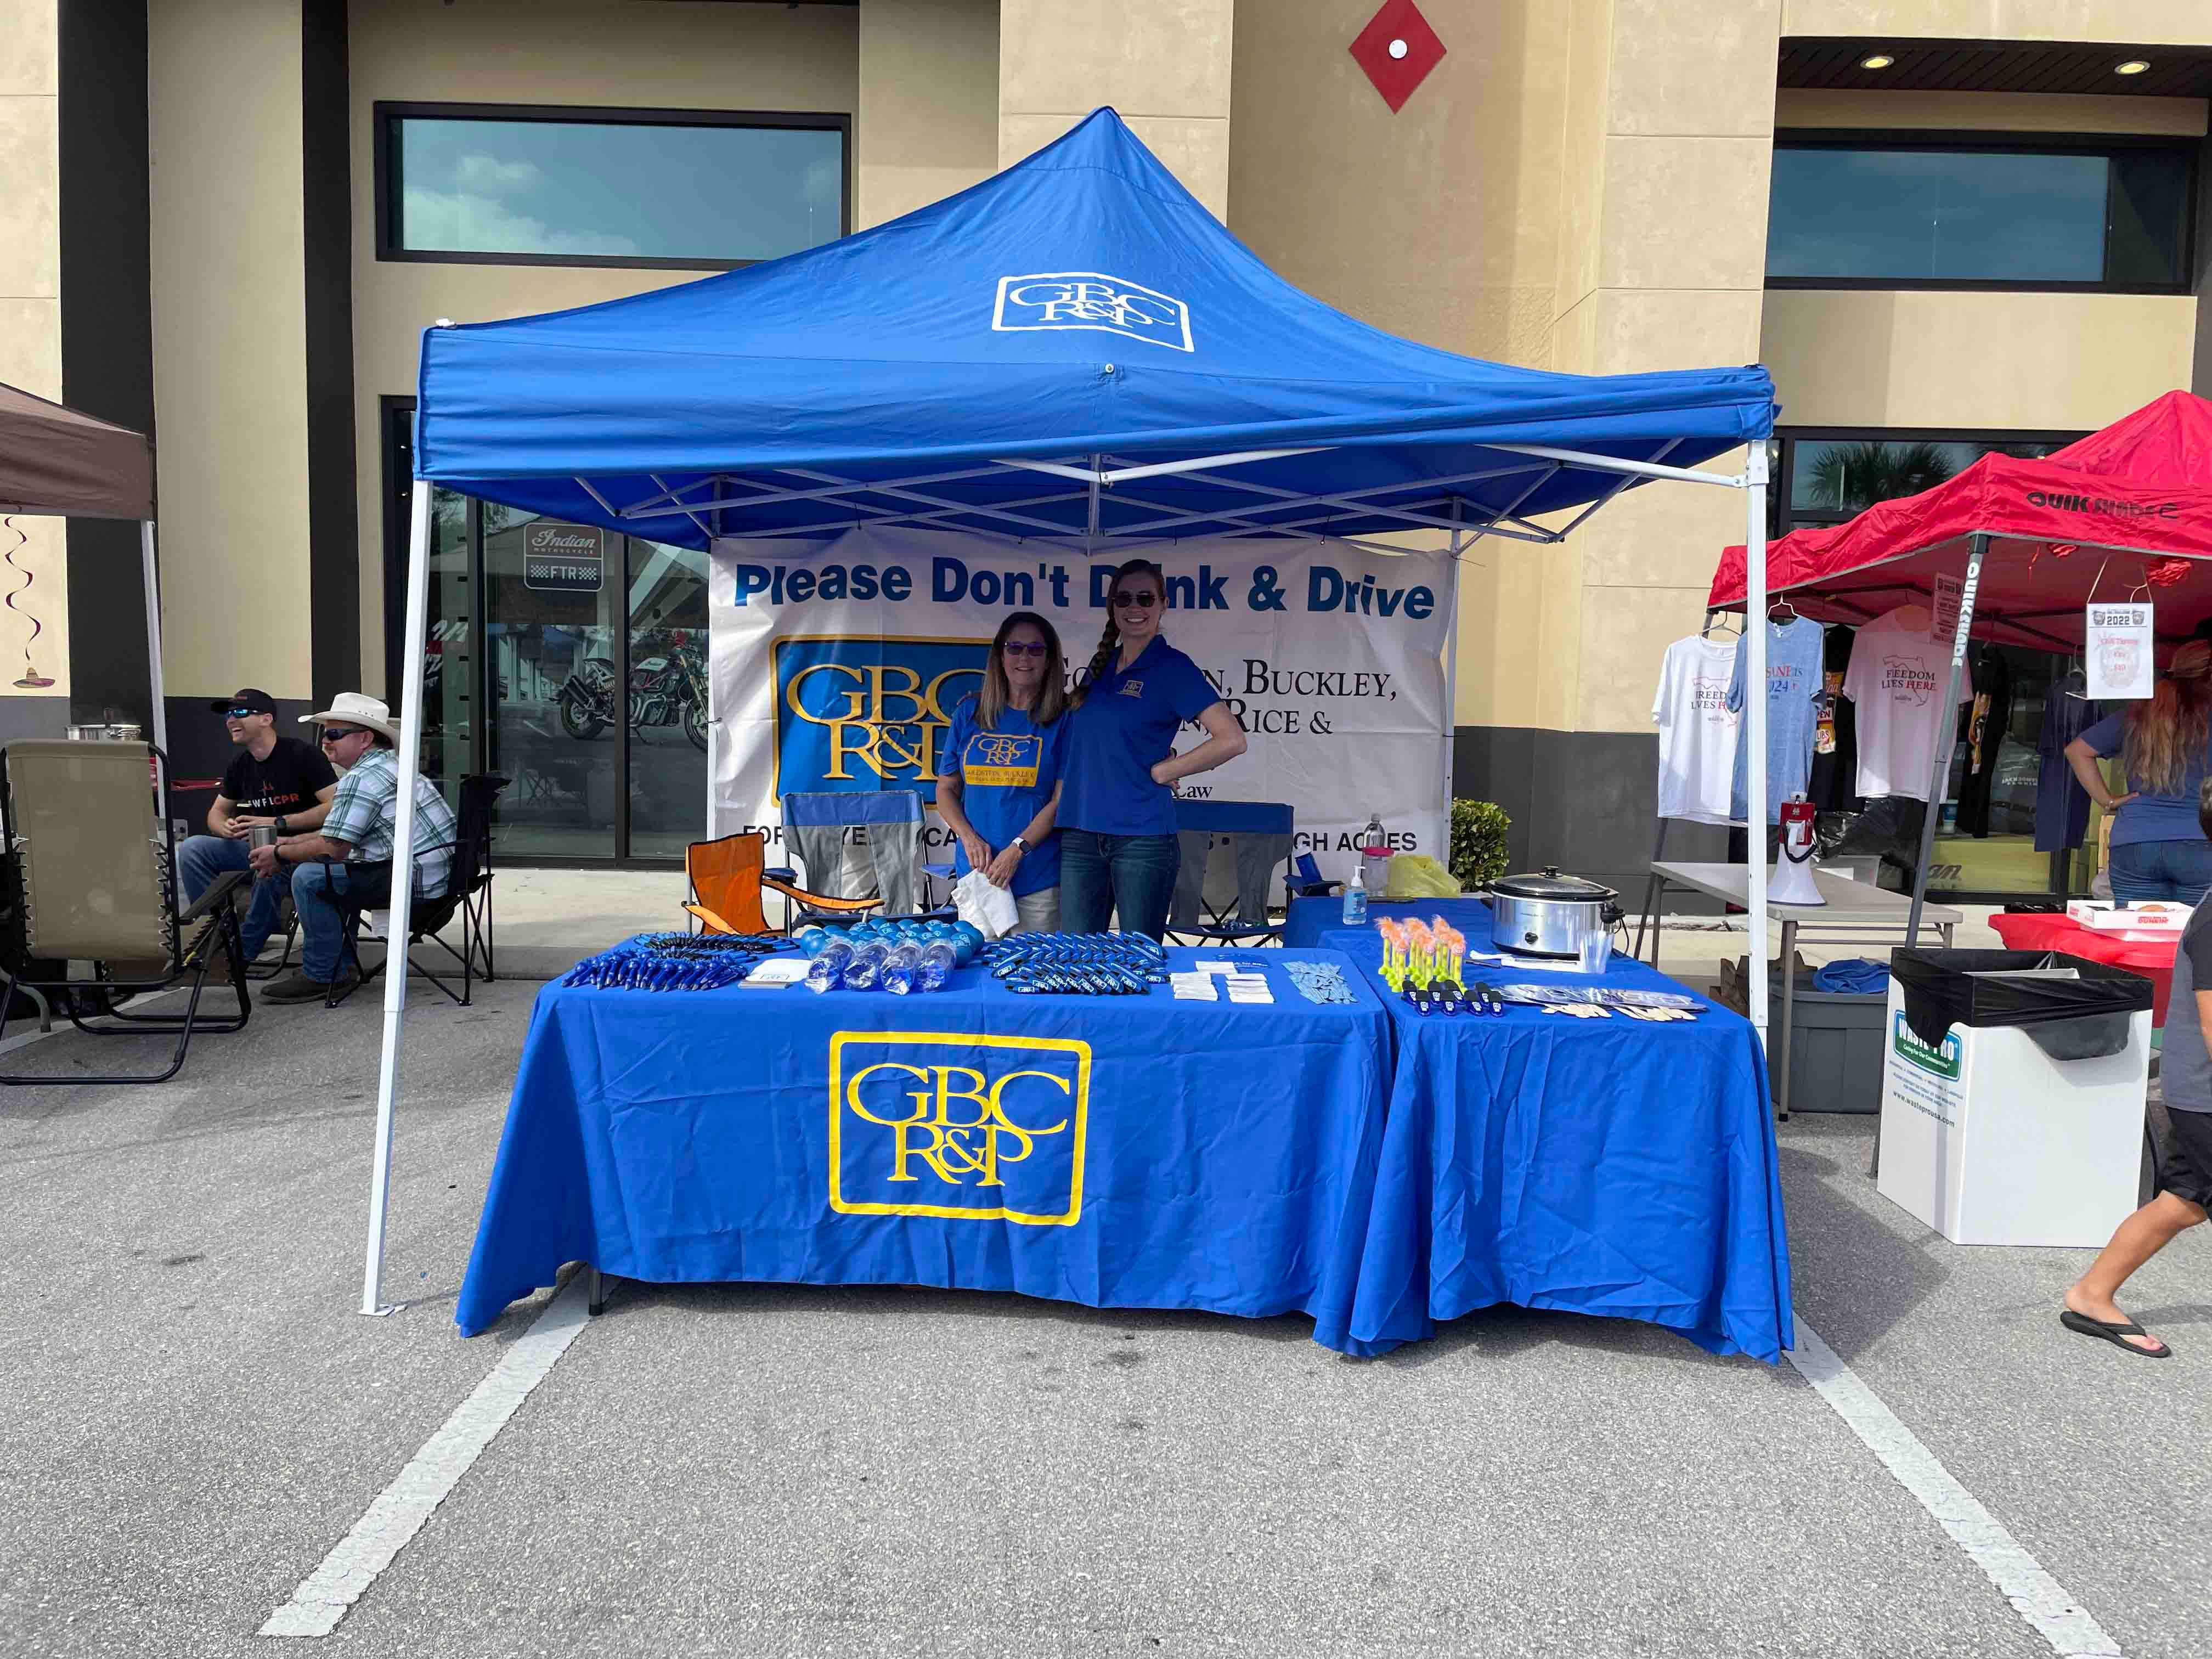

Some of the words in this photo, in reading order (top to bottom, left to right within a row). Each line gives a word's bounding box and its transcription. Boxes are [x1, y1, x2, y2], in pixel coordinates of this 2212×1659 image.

[1010, 283, 1176, 326] GBC
[1039, 301, 1154, 328] R&P
[2027, 492, 2090, 512] QUIK
[532, 529, 596, 548] Indian
[550, 566, 577, 580] FTR
[734, 563, 913, 607] Please
[932, 557, 1070, 607] Don't
[1090, 564, 1230, 610] Dnk
[1248, 565, 1287, 611] &
[1308, 566, 1435, 619] Drive
[2107, 616, 2130, 625] 2022
[1696, 691, 1726, 699] REED
[1906, 680, 1937, 691] HERE
[1310, 712, 1333, 734] &
[978, 738, 1031, 753] GBC
[1337, 832, 1417, 851] ACES
[847, 1062, 1070, 1135] GBC
[1893, 1091, 1955, 1128] www.wasteprousa.com
[887, 1121, 1034, 1187] R&P
